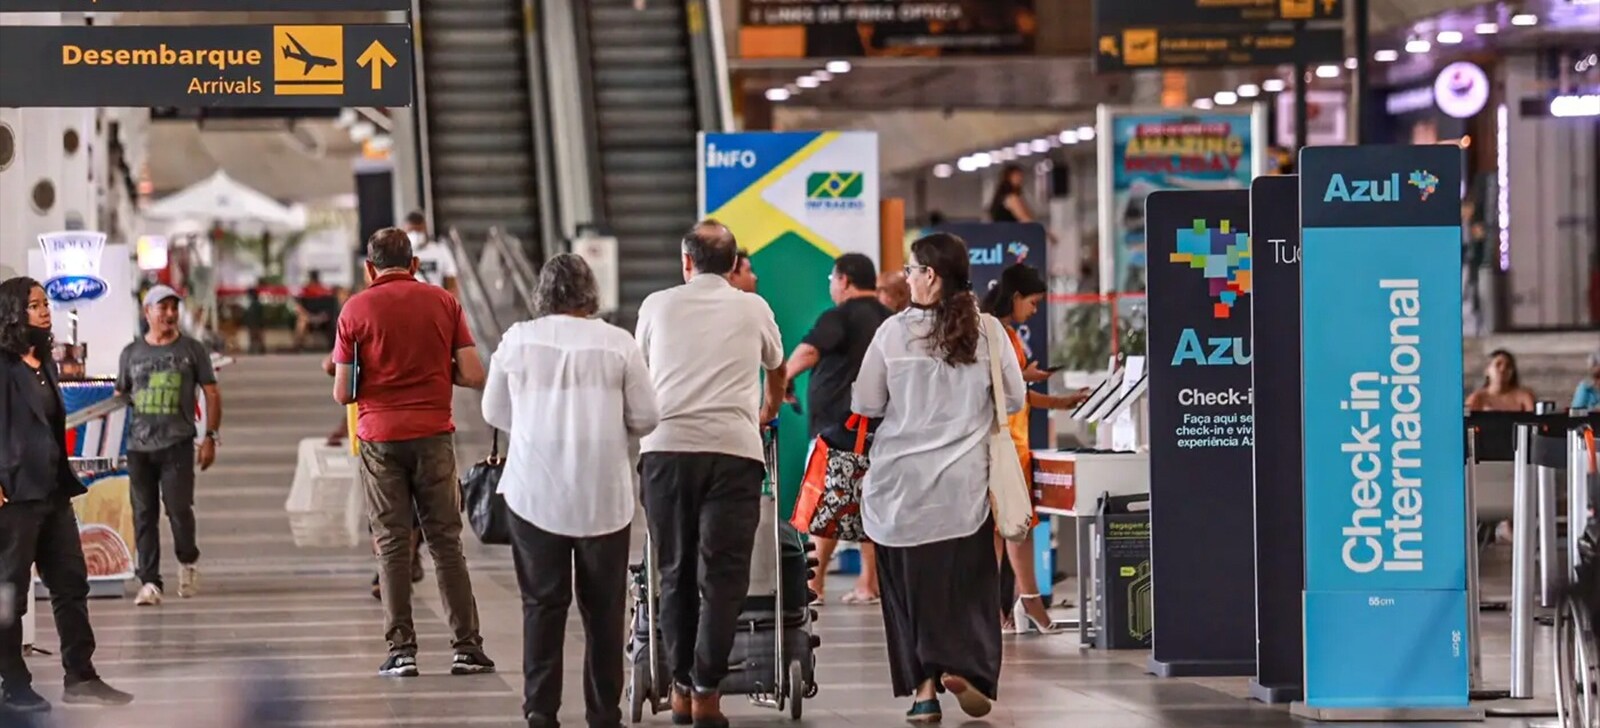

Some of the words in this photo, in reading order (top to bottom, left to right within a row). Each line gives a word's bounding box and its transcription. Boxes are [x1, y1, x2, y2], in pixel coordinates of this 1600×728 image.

[61, 43, 262, 70] Desembarque
[187, 76, 262, 95] Arrivals
[1323, 173, 1400, 203] Azul
[968, 243, 1003, 265] zul
[1171, 328, 1253, 366] Azu
[1178, 388, 1253, 406] Check-i
[1183, 413, 1211, 426] Faça
[1213, 412, 1237, 425] aqui
[1239, 414, 1253, 423] se
[1379, 278, 1424, 571] Internacional
[1176, 425, 1224, 436] check-in
[1177, 437, 1239, 449] experiência
[1241, 436, 1254, 446] Az
[1340, 371, 1382, 573] Check-in
